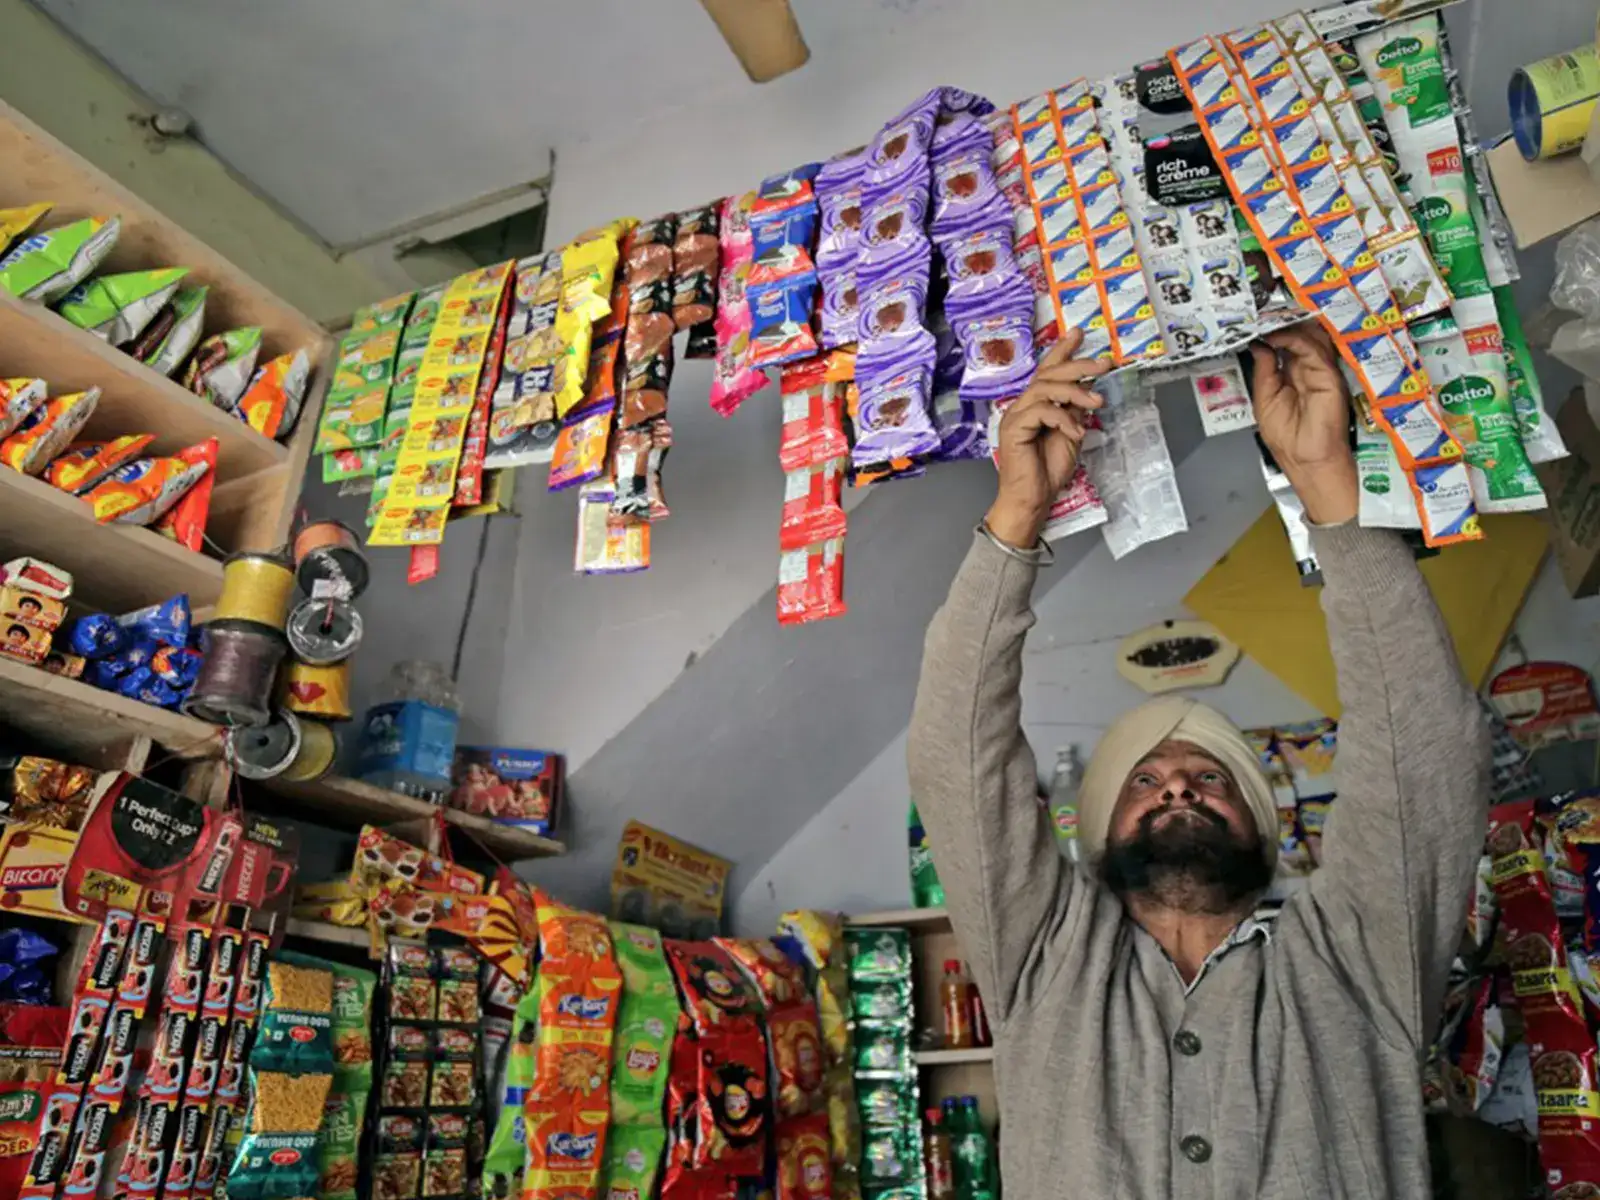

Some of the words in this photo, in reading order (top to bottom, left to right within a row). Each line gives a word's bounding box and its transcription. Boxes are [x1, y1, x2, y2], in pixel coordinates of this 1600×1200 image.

[1379, 42, 1420, 63] Dettol
[1157, 158, 1187, 173] rich
[1424, 205, 1449, 221] ttol
[1441, 385, 1493, 406] Dettol
[129, 800, 172, 827] Perfect
[132, 818, 160, 840] Only
